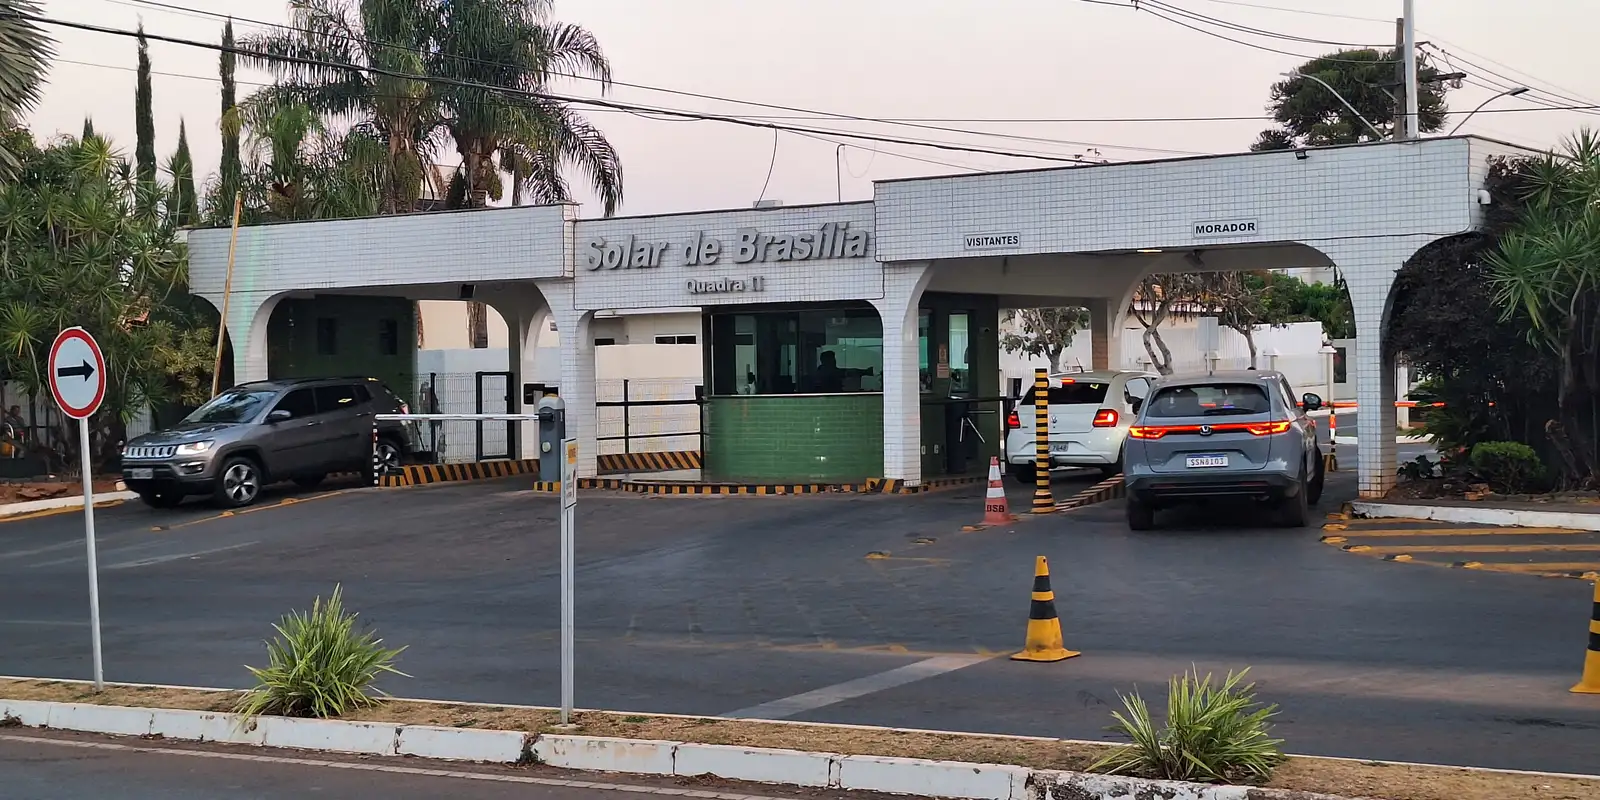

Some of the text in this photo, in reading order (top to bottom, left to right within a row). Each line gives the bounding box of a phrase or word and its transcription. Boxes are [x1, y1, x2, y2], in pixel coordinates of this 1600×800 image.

[1195, 222, 1256, 234] MORADOR
[585, 221, 869, 271] Solar de Brasília
[966, 235, 1018, 247] VISITANTES
[685, 277, 745, 294] Quadra
